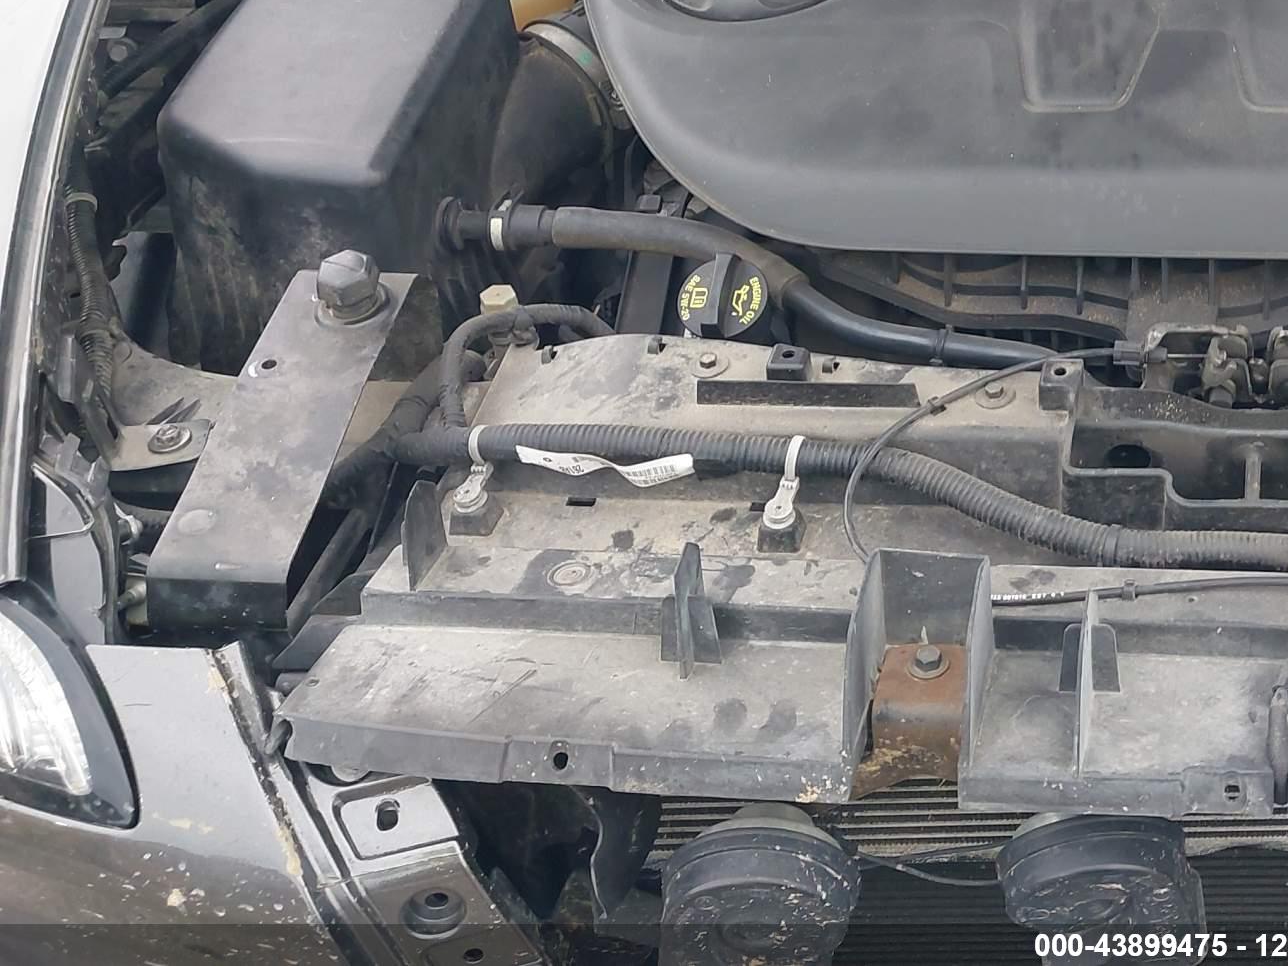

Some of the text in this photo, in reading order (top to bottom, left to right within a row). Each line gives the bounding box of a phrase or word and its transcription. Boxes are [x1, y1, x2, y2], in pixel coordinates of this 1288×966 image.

[684, 274, 701, 292] SAE
[739, 276, 762, 325] ENGINE OIL
